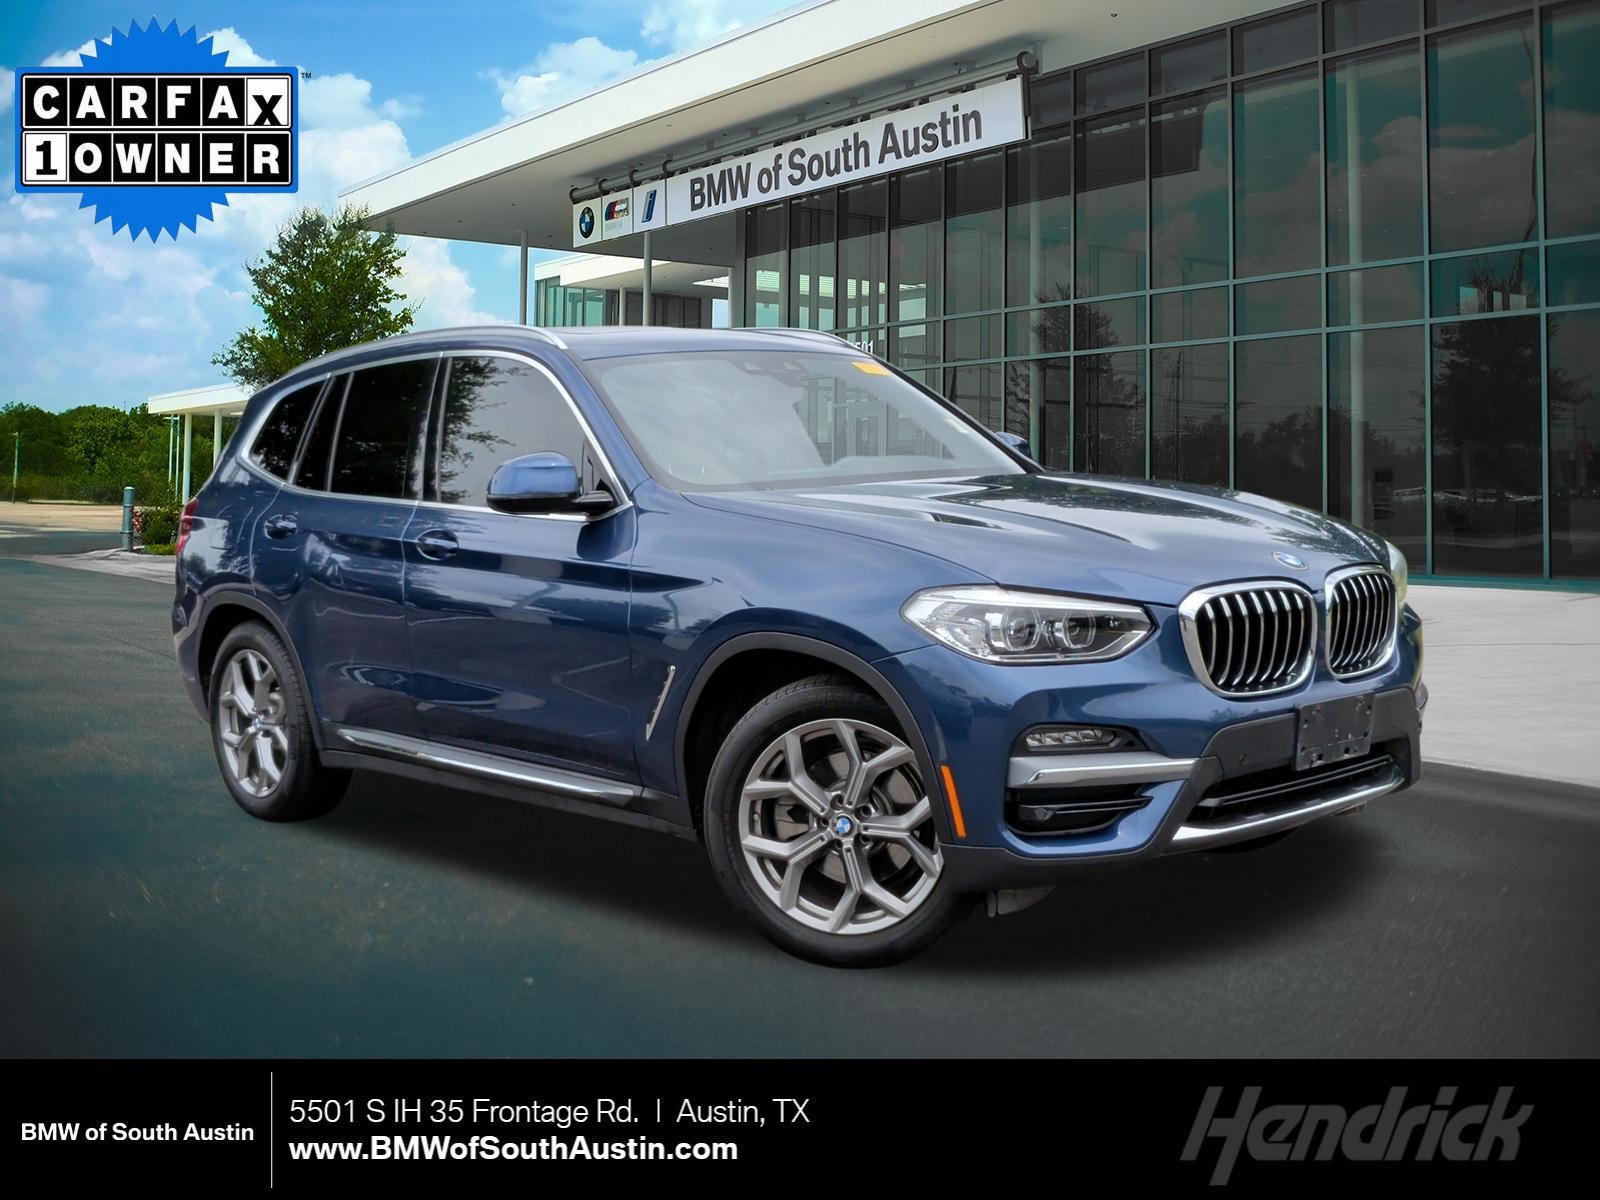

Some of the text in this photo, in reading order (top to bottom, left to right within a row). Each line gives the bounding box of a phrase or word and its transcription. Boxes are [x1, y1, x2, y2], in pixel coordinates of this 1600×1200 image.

[690, 104, 983, 212] BMW of South Austin
